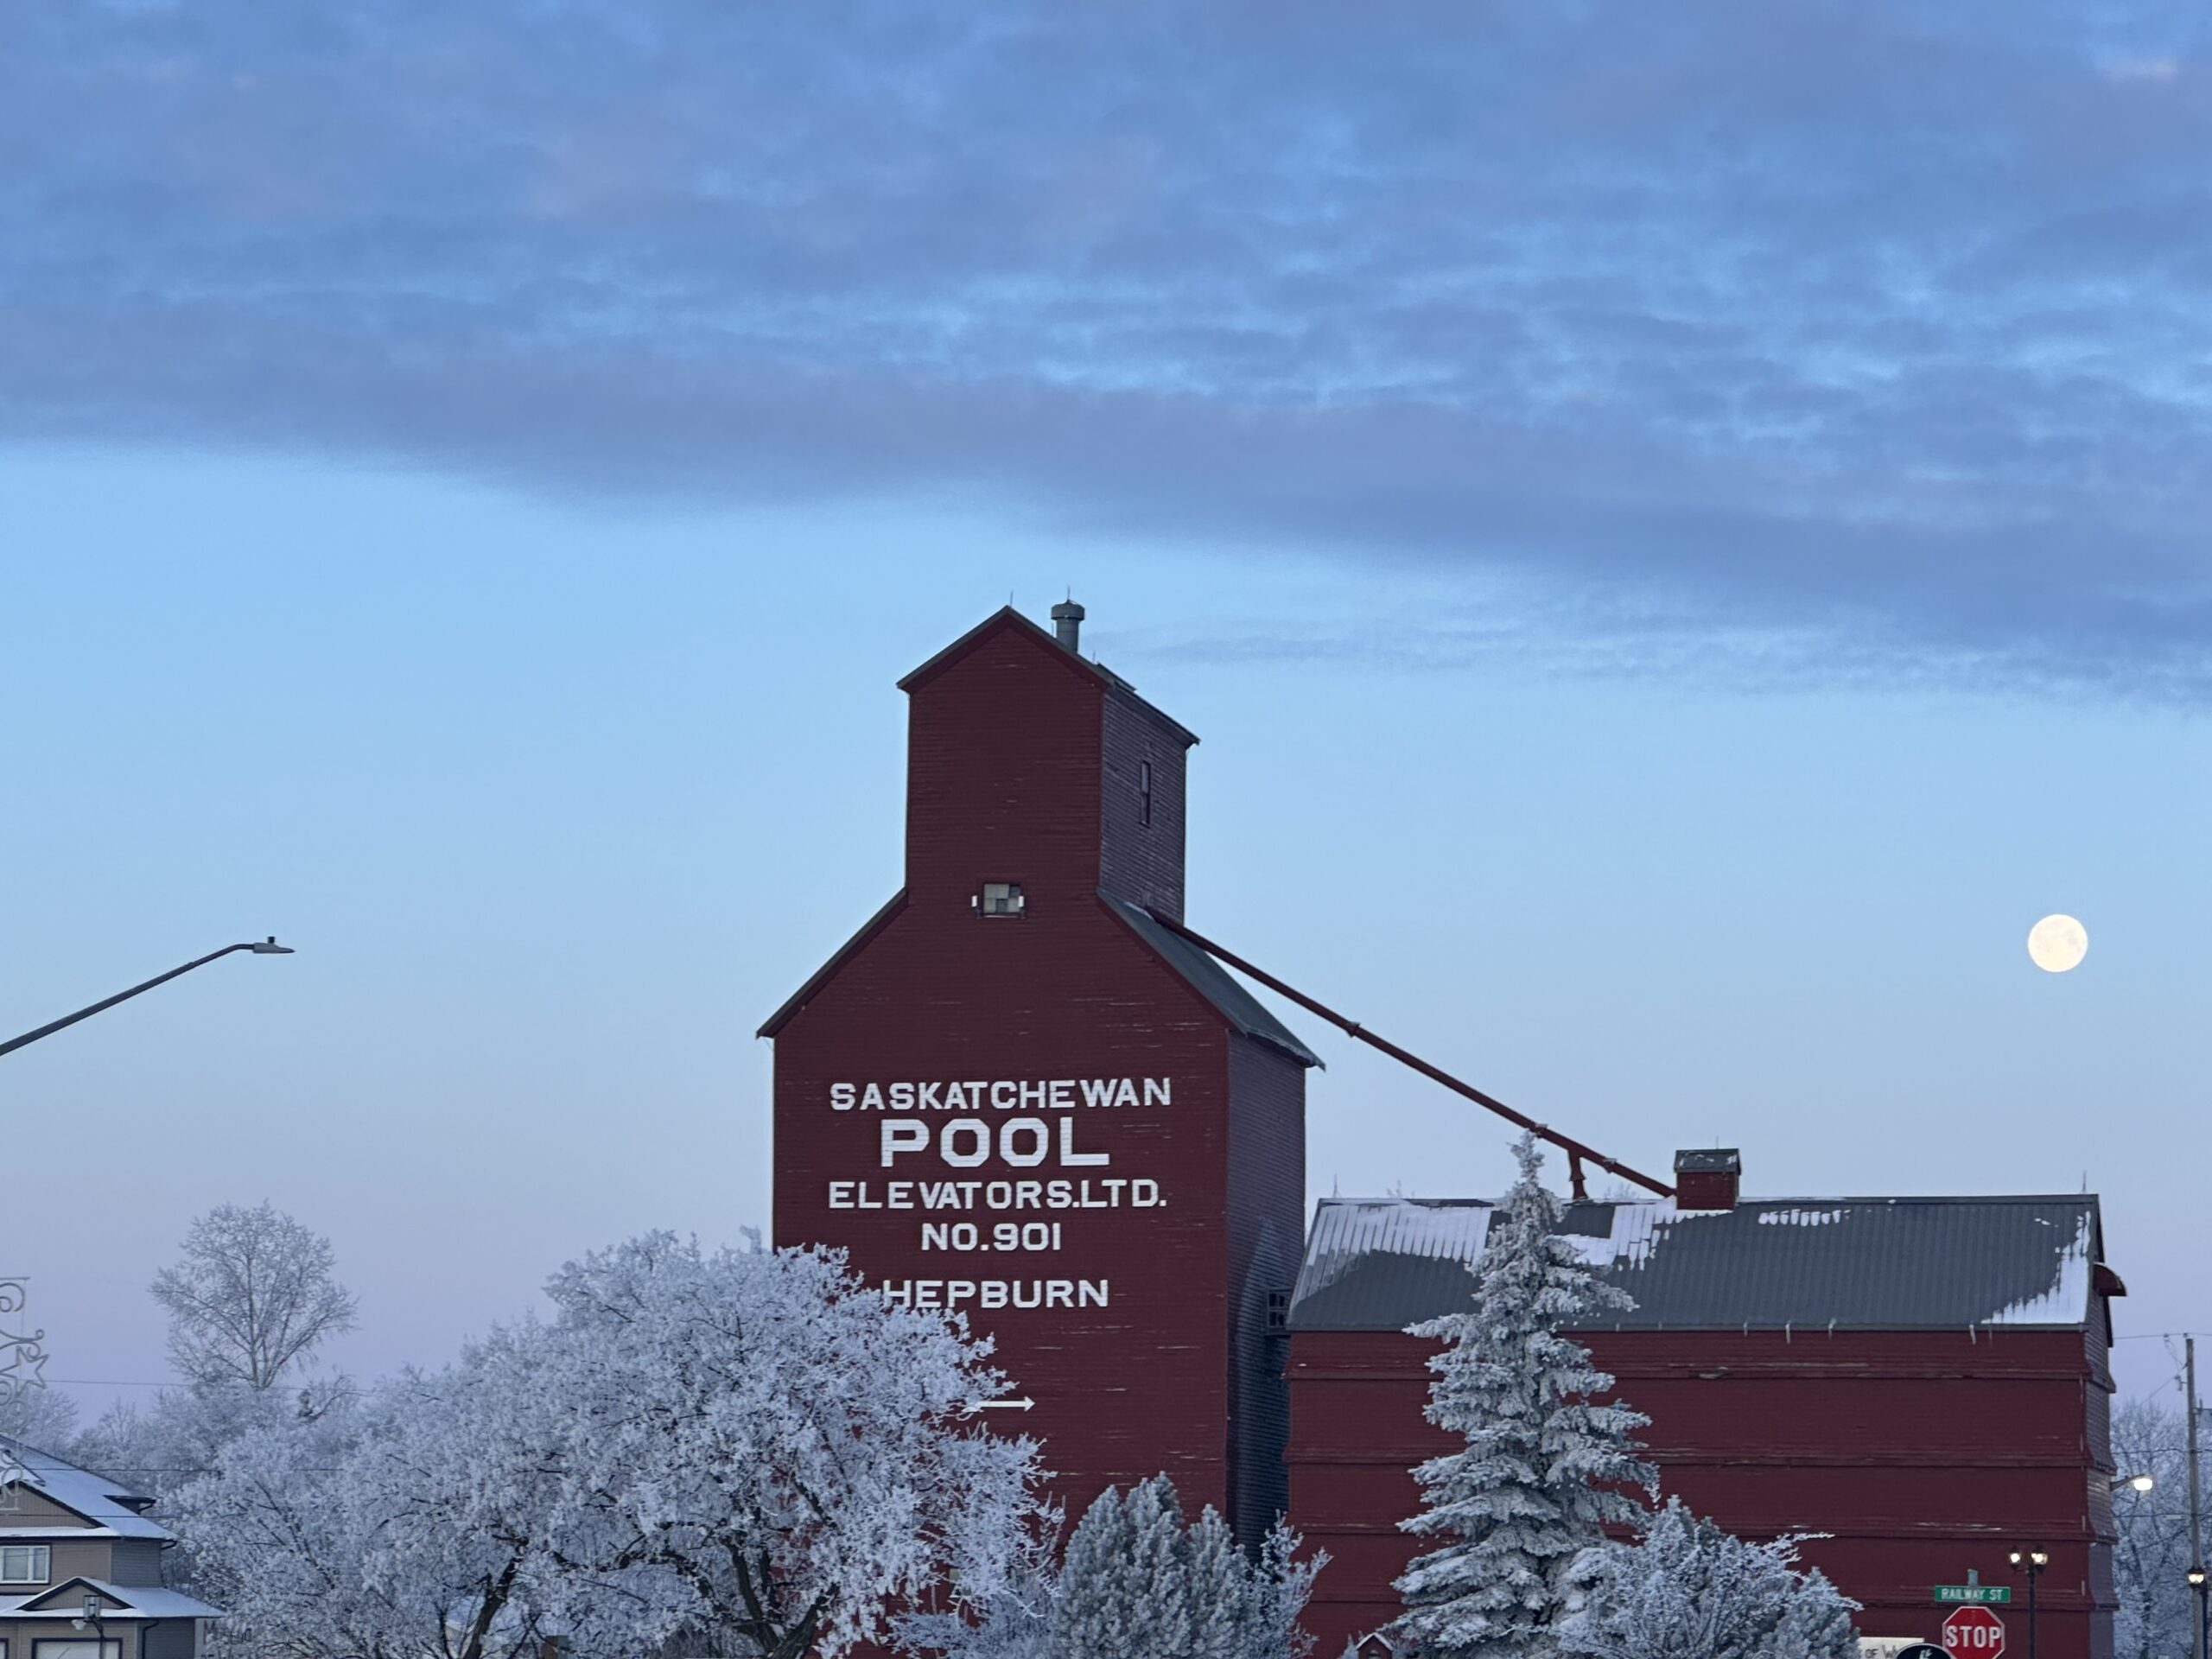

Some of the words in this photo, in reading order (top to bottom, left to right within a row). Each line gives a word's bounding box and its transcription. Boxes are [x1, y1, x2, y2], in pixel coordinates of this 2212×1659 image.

[830, 1077, 1171, 1110] SASKATCHEWAN
[880, 1116, 1110, 1167] POOL
[883, 1279, 1109, 1308] HEPBURN
[1941, 1588, 1985, 1600] RAILWAY
[1989, 1589, 2003, 1601] ST
[1946, 1625, 2001, 1649] STOP
